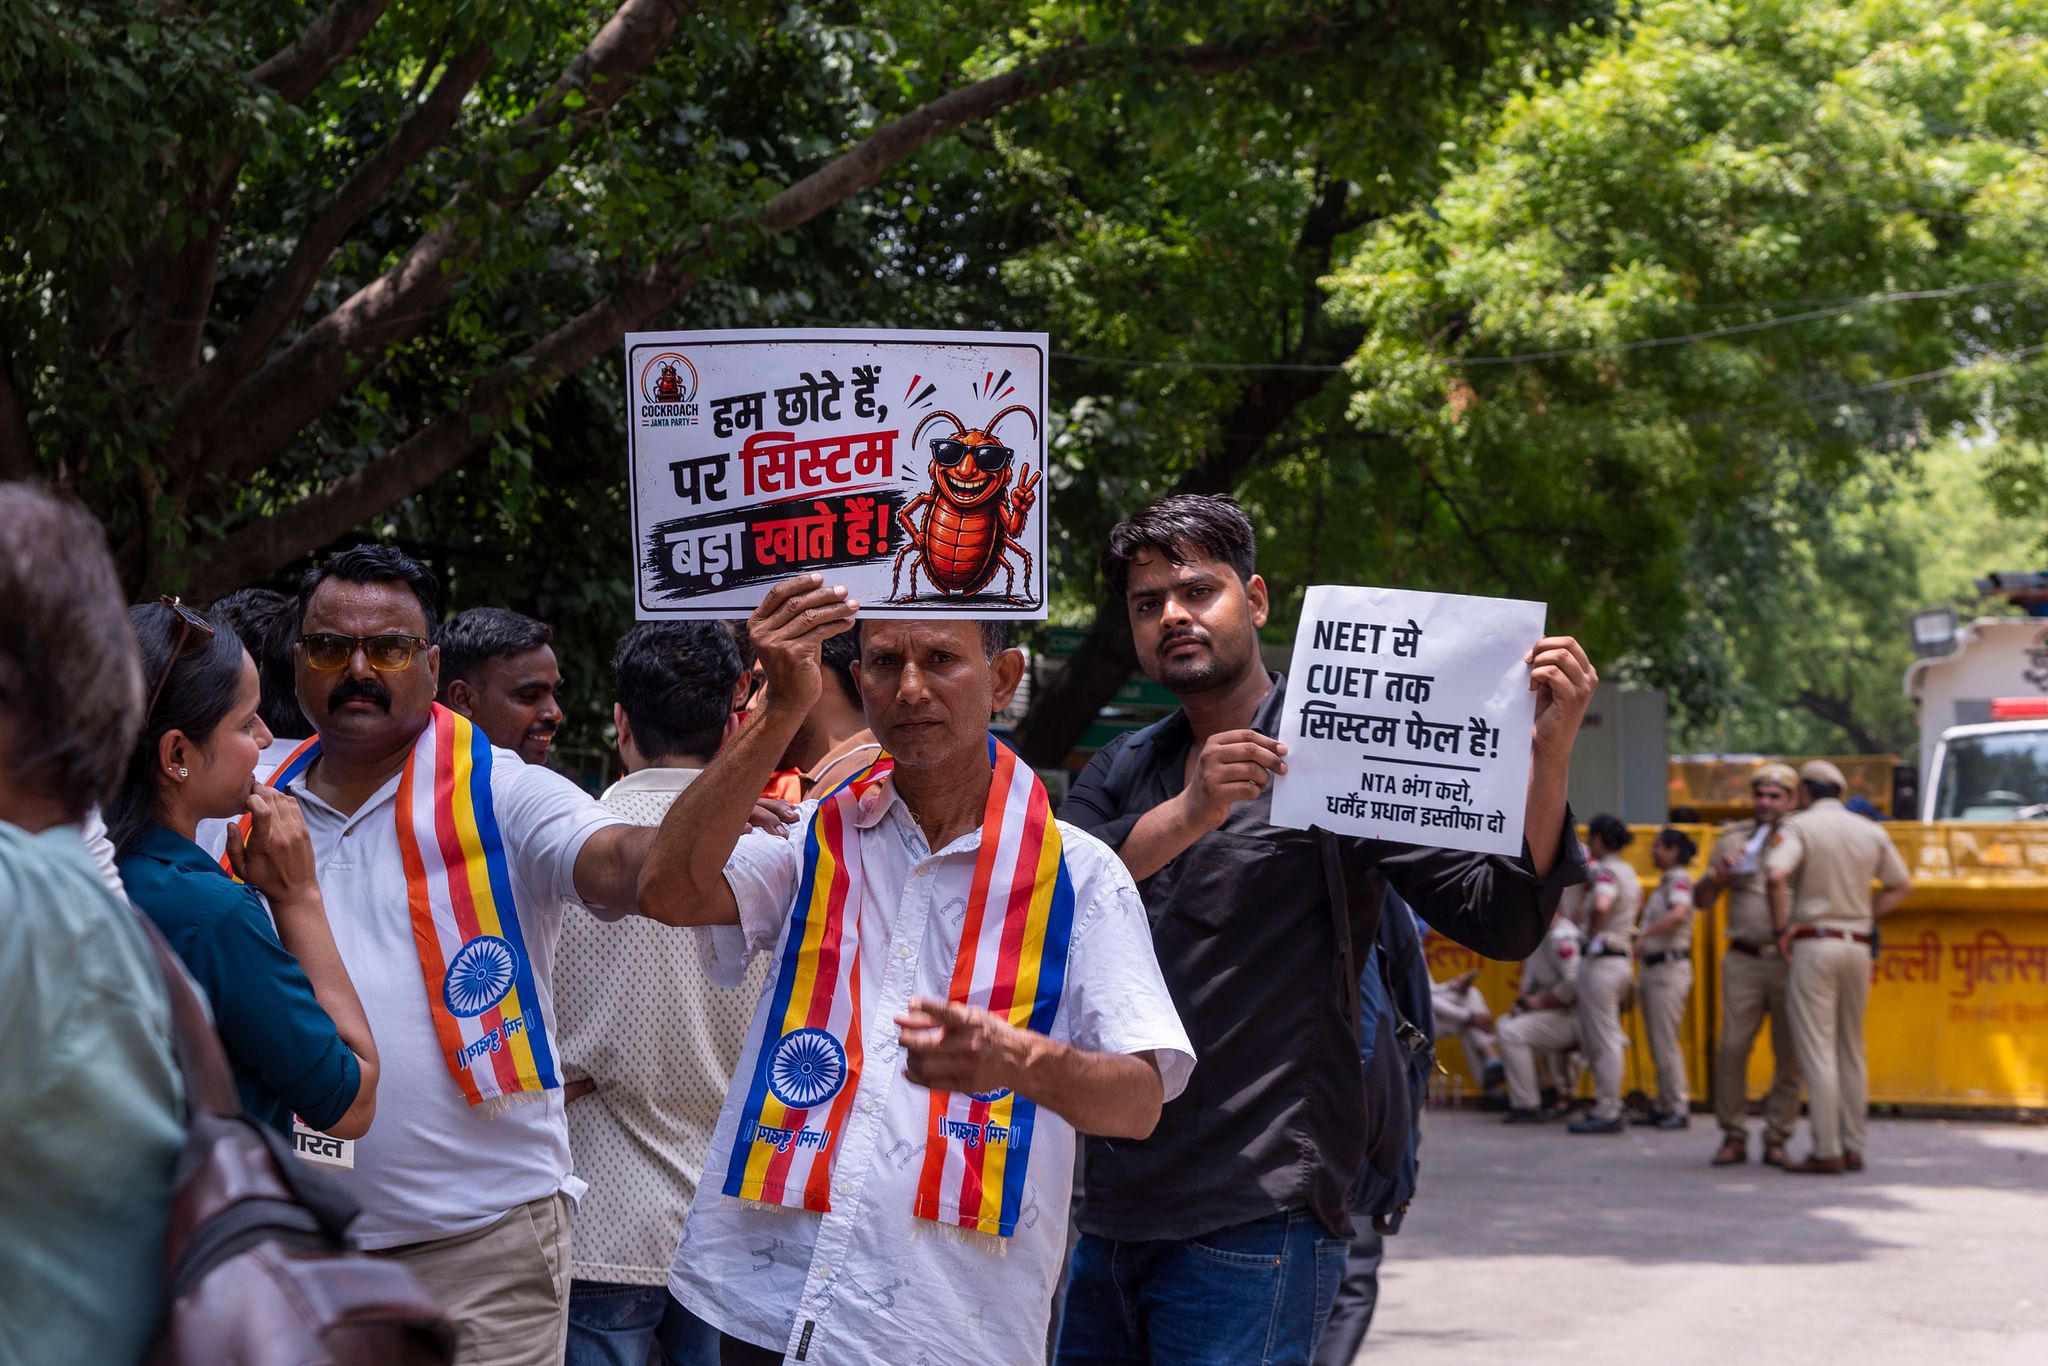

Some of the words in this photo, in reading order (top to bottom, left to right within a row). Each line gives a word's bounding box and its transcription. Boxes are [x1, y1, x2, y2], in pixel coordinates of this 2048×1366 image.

[642, 404, 699, 417] COCKROACH
[710, 391, 766, 439] हम
[774, 370, 844, 426] छोटे
[851, 364, 888, 424] हैं,
[650, 418, 670, 428] JANTA
[670, 418, 690, 427] PARTY
[669, 453, 730, 505] पर
[738, 430, 899, 496] सिस्टम
[664, 521, 746, 586] बड़ा
[752, 501, 838, 567] खाते
[844, 497, 889, 556] हैं!
[1313, 620, 1387, 654] NEET
[1392, 619, 1423, 659] से
[1306, 664, 1379, 699] CUET
[1384, 671, 1435, 704] तक
[1300, 700, 1401, 747] सिस्टम
[1405, 711, 1464, 754] फेल
[1468, 716, 1501, 759] है!
[1361, 773, 1397, 795] NTA
[1402, 774, 1432, 799] भंग
[1435, 779, 1474, 806] करो,
[1326, 791, 1368, 819] धर्मेंद्र
[1370, 801, 1417, 824] प्रधान
[1420, 805, 1484, 833] इस्तीफा
[1487, 810, 1506, 834] दो
[293, 1130, 345, 1159] ारत
